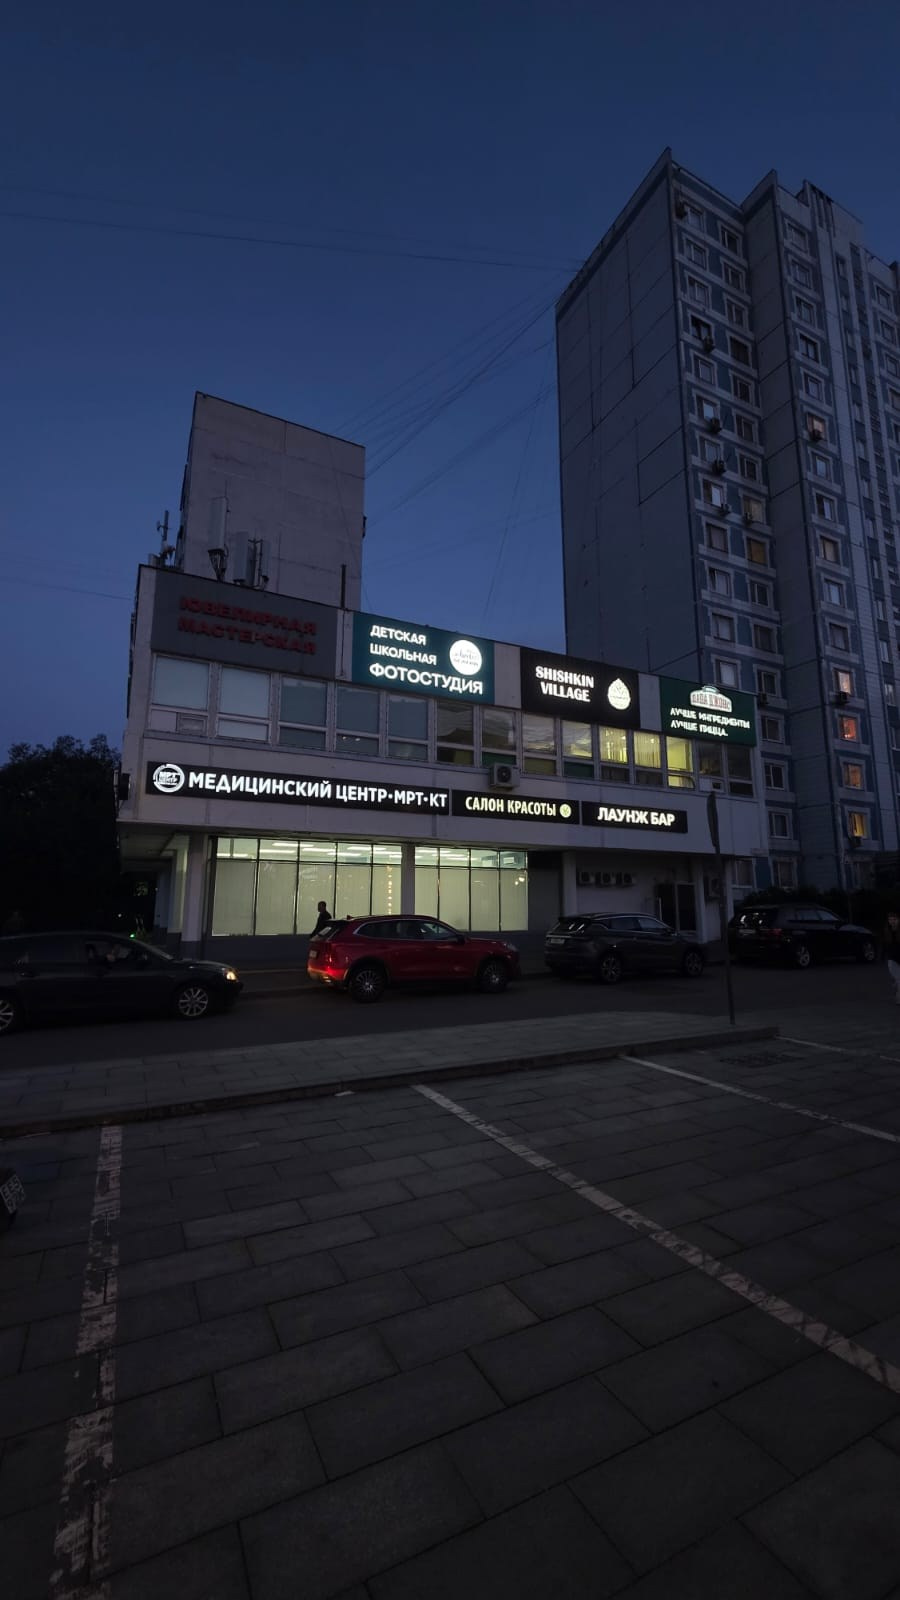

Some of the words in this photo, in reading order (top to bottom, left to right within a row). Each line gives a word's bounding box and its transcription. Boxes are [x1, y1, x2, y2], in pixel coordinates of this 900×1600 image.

[180, 596, 317, 636] ЮВЕЛИРНАЯ
[178, 616, 317, 654] МАСТЕРСКАЯ
[370, 624, 427, 646] ДЕТСКАЯ
[370, 642, 437, 666] ШКОЛЬНАЯ
[369, 662, 484, 695] ФОТОСТУДИЯ
[535, 665, 595, 689] SHISHKIN
[540, 681, 591, 703] VILLAGE
[670, 707, 697, 719] ЛУЧШЕ
[670, 719, 698, 731] ЛУЧШЕ
[188, 771, 332, 799] МЕДИЦИНСКИЙ
[465, 796, 505, 813] САЛОН
[507, 799, 557, 817] КРАСОТЫ
[597, 806, 649, 825] ЛАУНЖ
[650, 811, 676, 827] БАР
